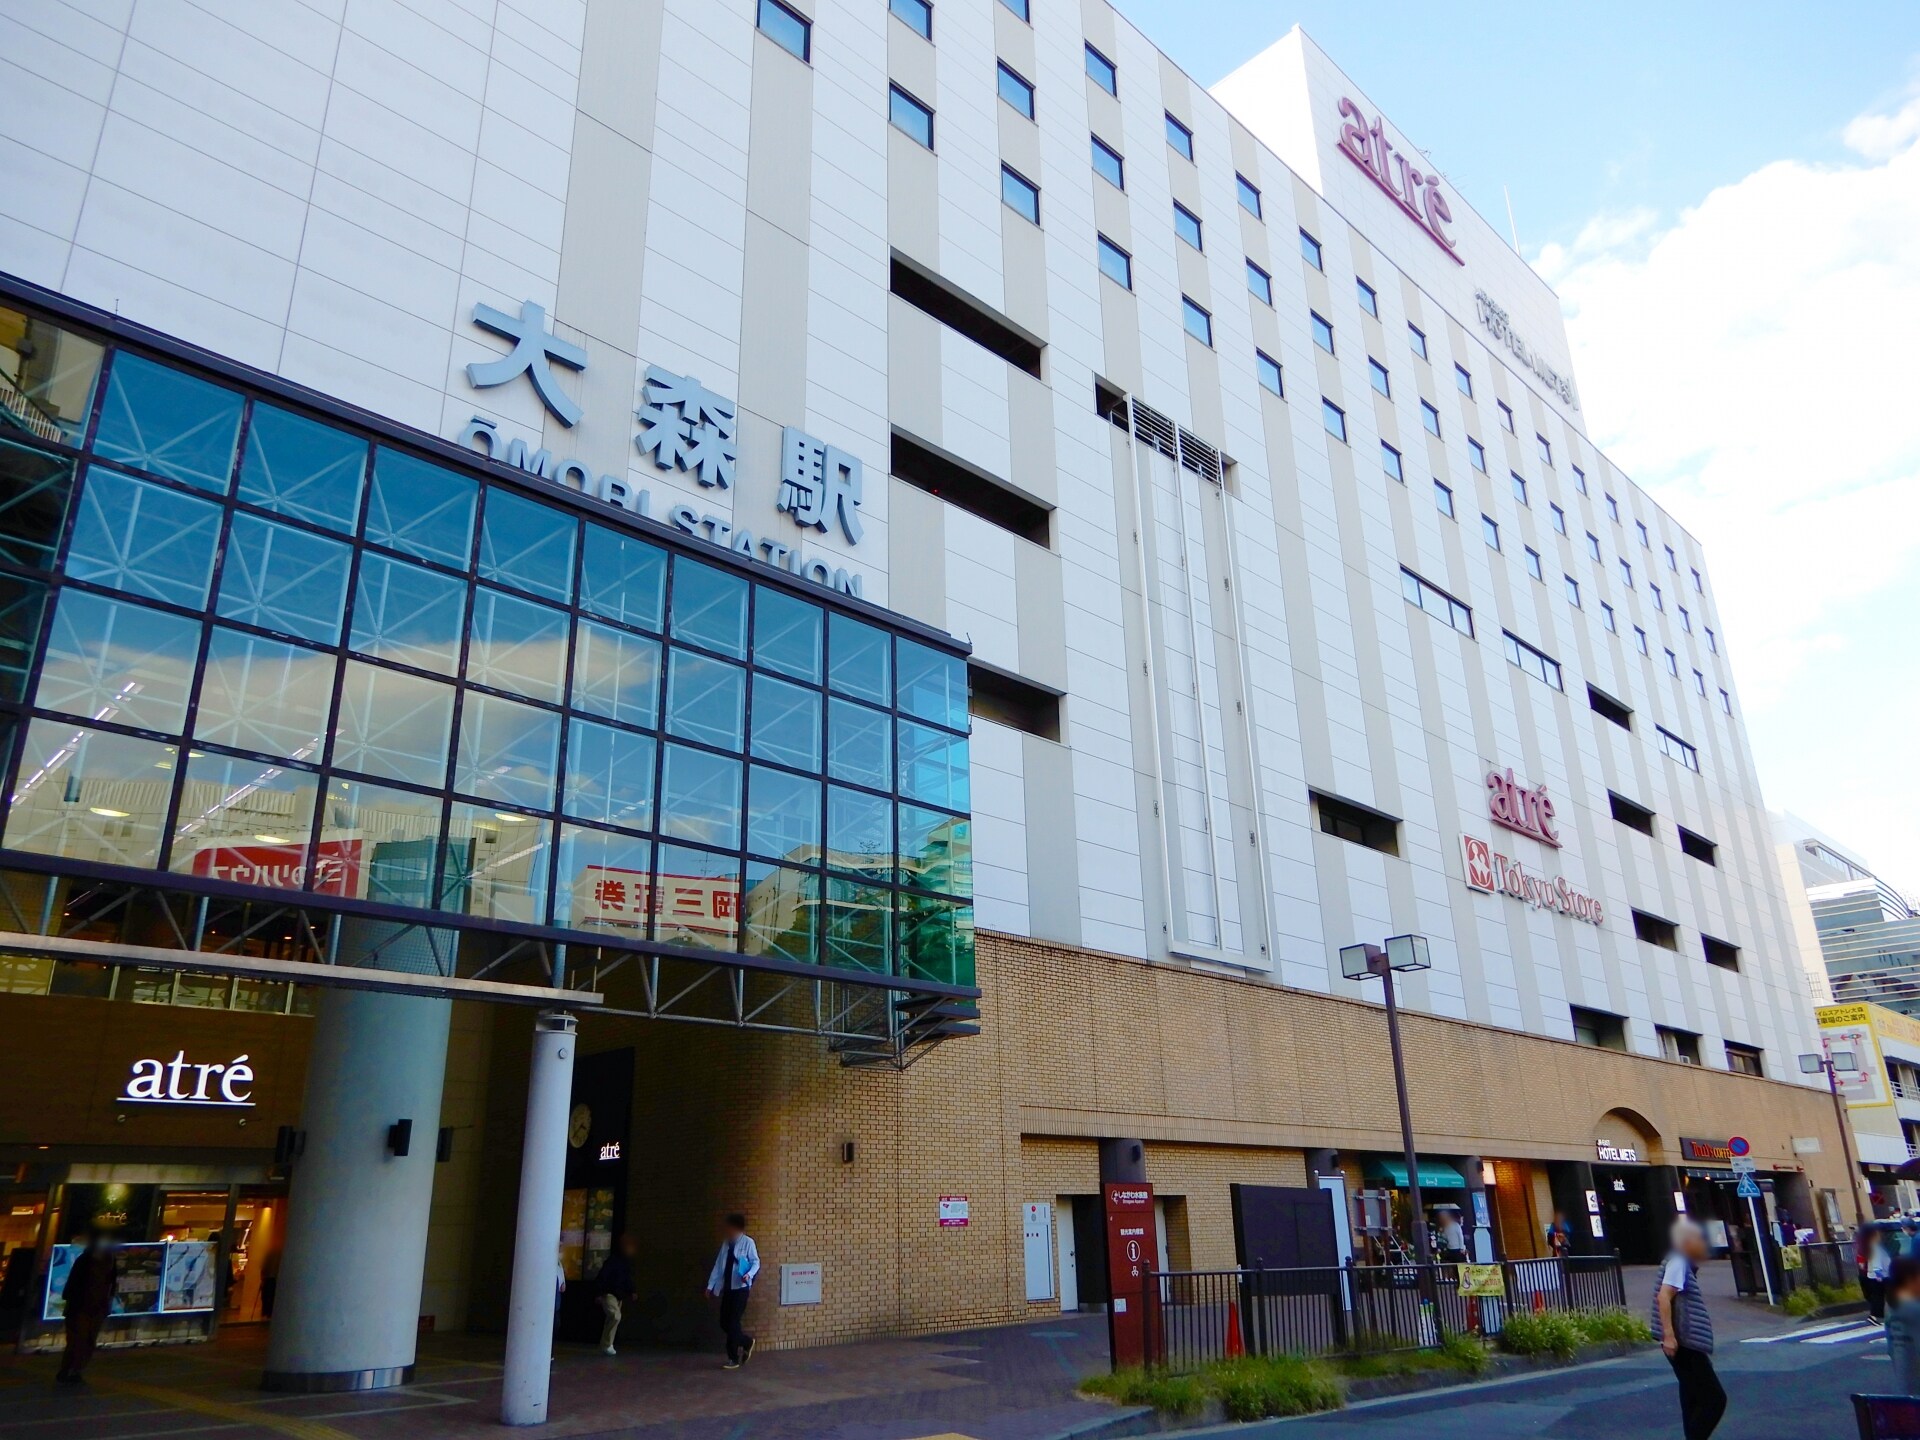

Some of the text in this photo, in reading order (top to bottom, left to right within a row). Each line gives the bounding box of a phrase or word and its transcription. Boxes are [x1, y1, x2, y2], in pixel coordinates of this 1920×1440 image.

[1337, 97, 1458, 249] atré
[466, 299, 864, 546] 大森駅
[669, 504, 863, 600] STATION
[1487, 768, 1560, 842] atré
[1493, 852, 1604, 924] Tokyu Store
[1814, 1006, 1864, 1017] イムズアトレ大森
[126, 1050, 254, 1102] atré
[600, 1141, 620, 1159] atré
[1598, 1146, 1621, 1160] HOTEL
